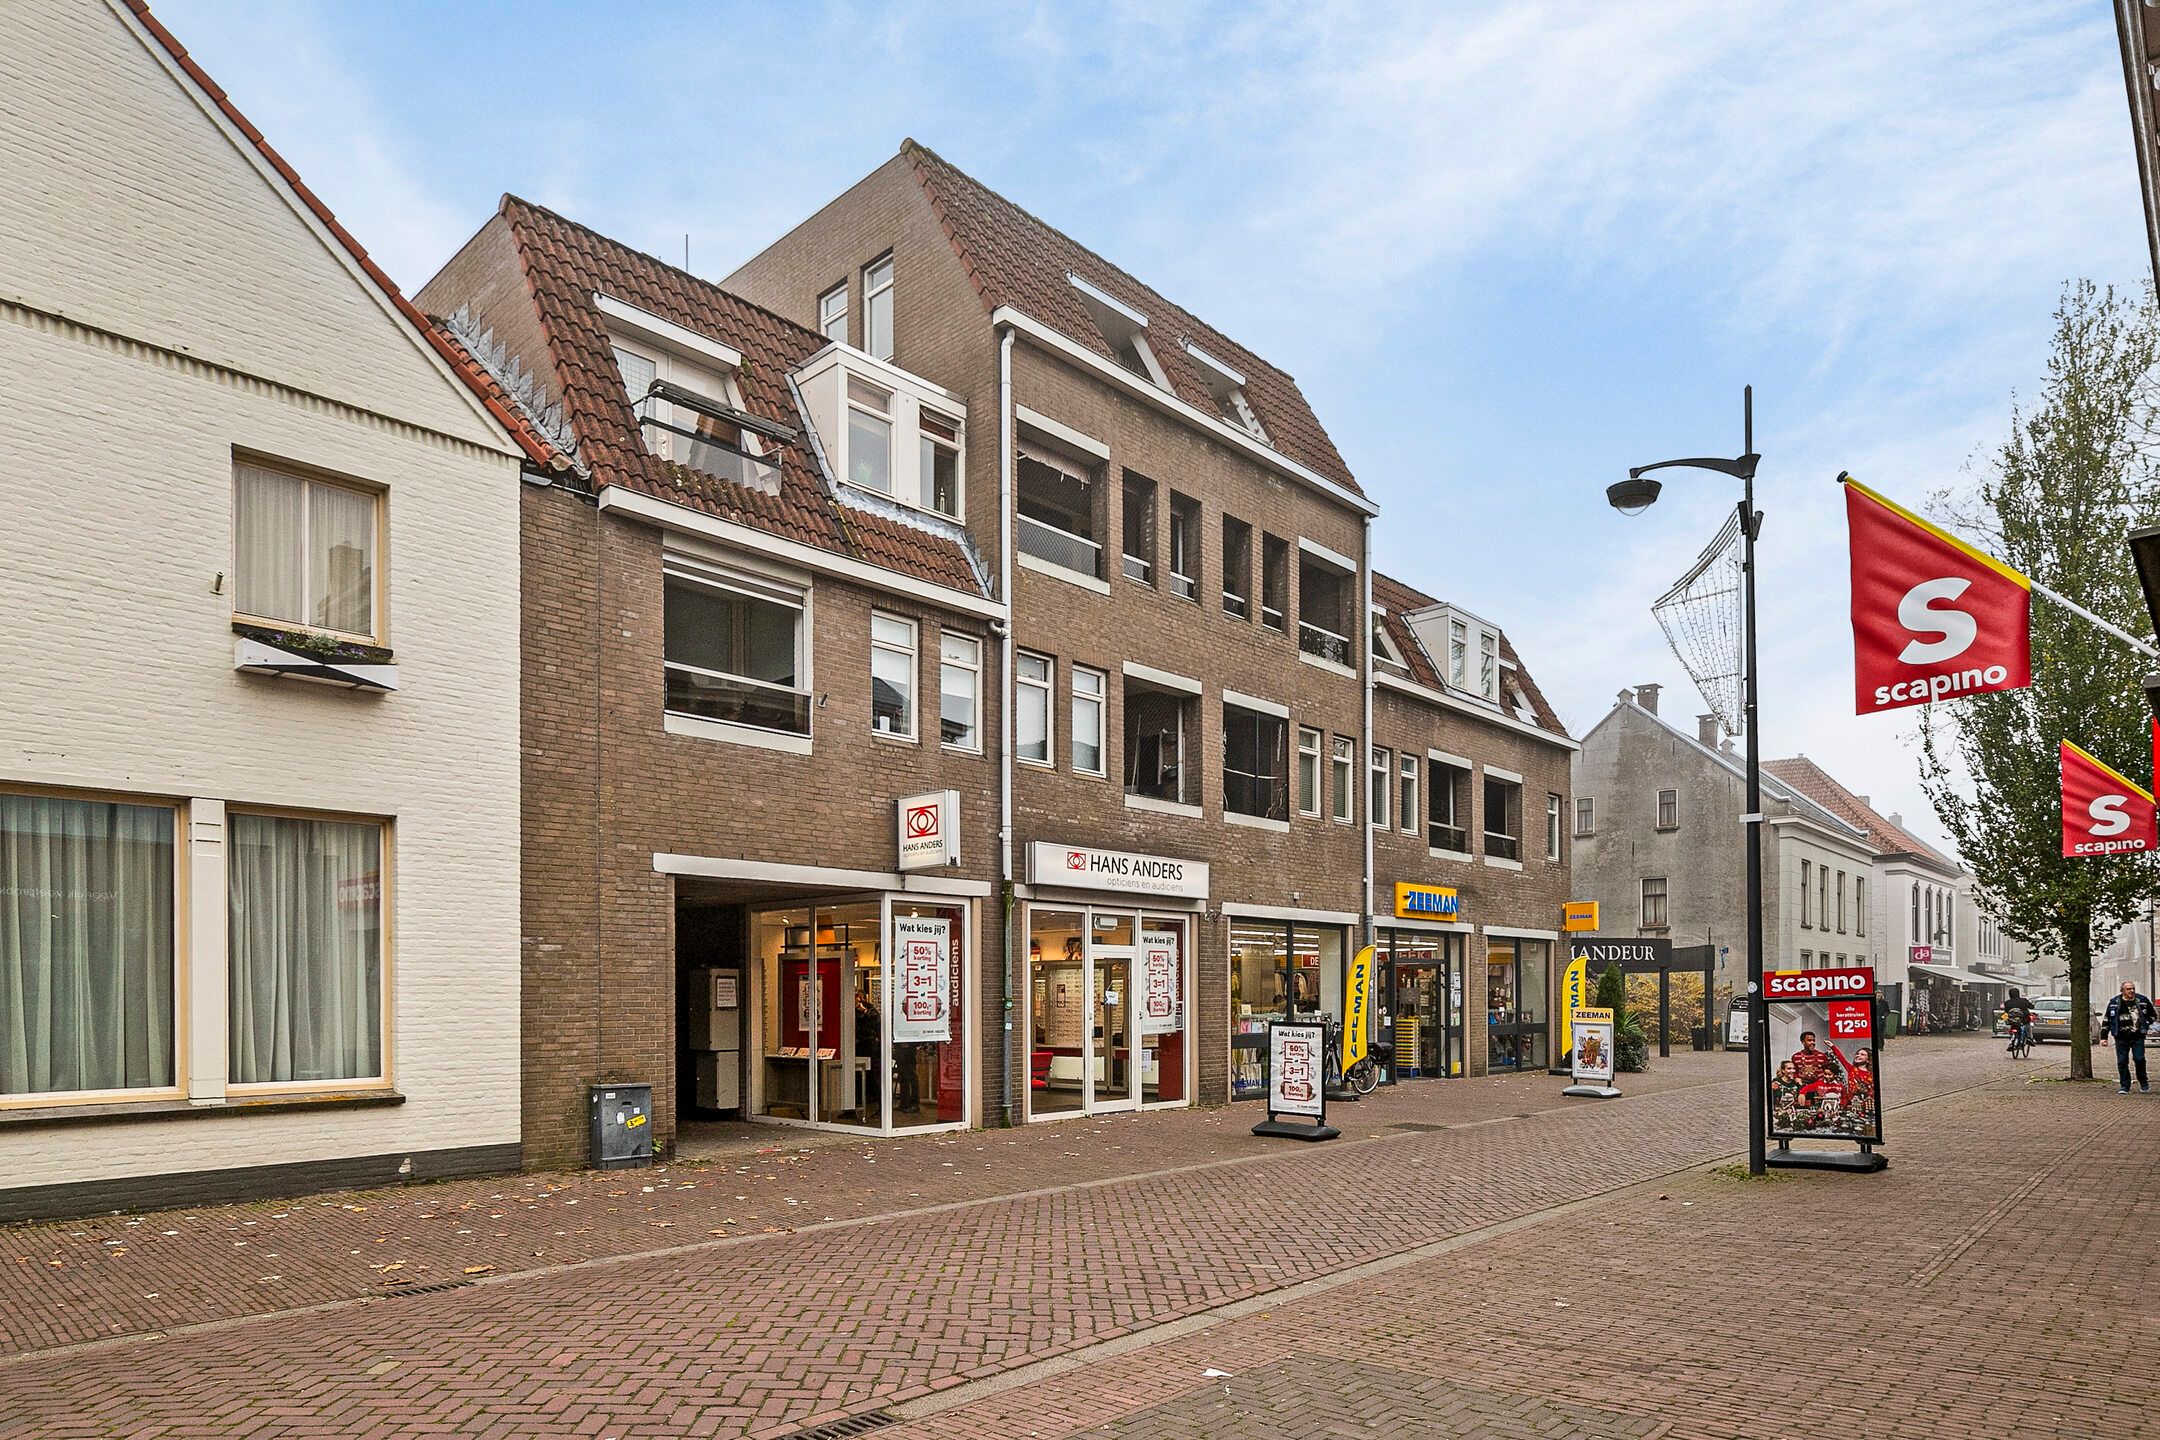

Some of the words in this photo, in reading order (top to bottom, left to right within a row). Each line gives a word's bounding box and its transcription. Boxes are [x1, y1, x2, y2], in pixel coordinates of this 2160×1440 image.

[1874, 665, 2008, 705] scapino
[903, 843, 919, 852] HANS
[920, 840, 943, 850] ANDERS
[2074, 839, 2146, 854] scapino
[1091, 854, 1129, 875] HANS
[1132, 859, 1183, 880] ANDERS
[1106, 877, 1140, 889] opticiens
[1152, 882, 1184, 892] audiciens
[1408, 891, 1459, 913] ZEEMAN
[900, 923, 915, 933] Wat
[917, 924, 933, 933] kies
[934, 925, 946, 935] jij?
[913, 946, 931, 955] 50%
[951, 939, 959, 1007] audiciens
[914, 976, 932, 986] 3=1
[1153, 979, 1165, 988] 3=1
[1770, 975, 1866, 997] scapino
[1350, 964, 1365, 1058] ZEEMAN
[1576, 1011, 1611, 1019] ZEEMAN
[1289, 1067, 1303, 1075] 3=1
